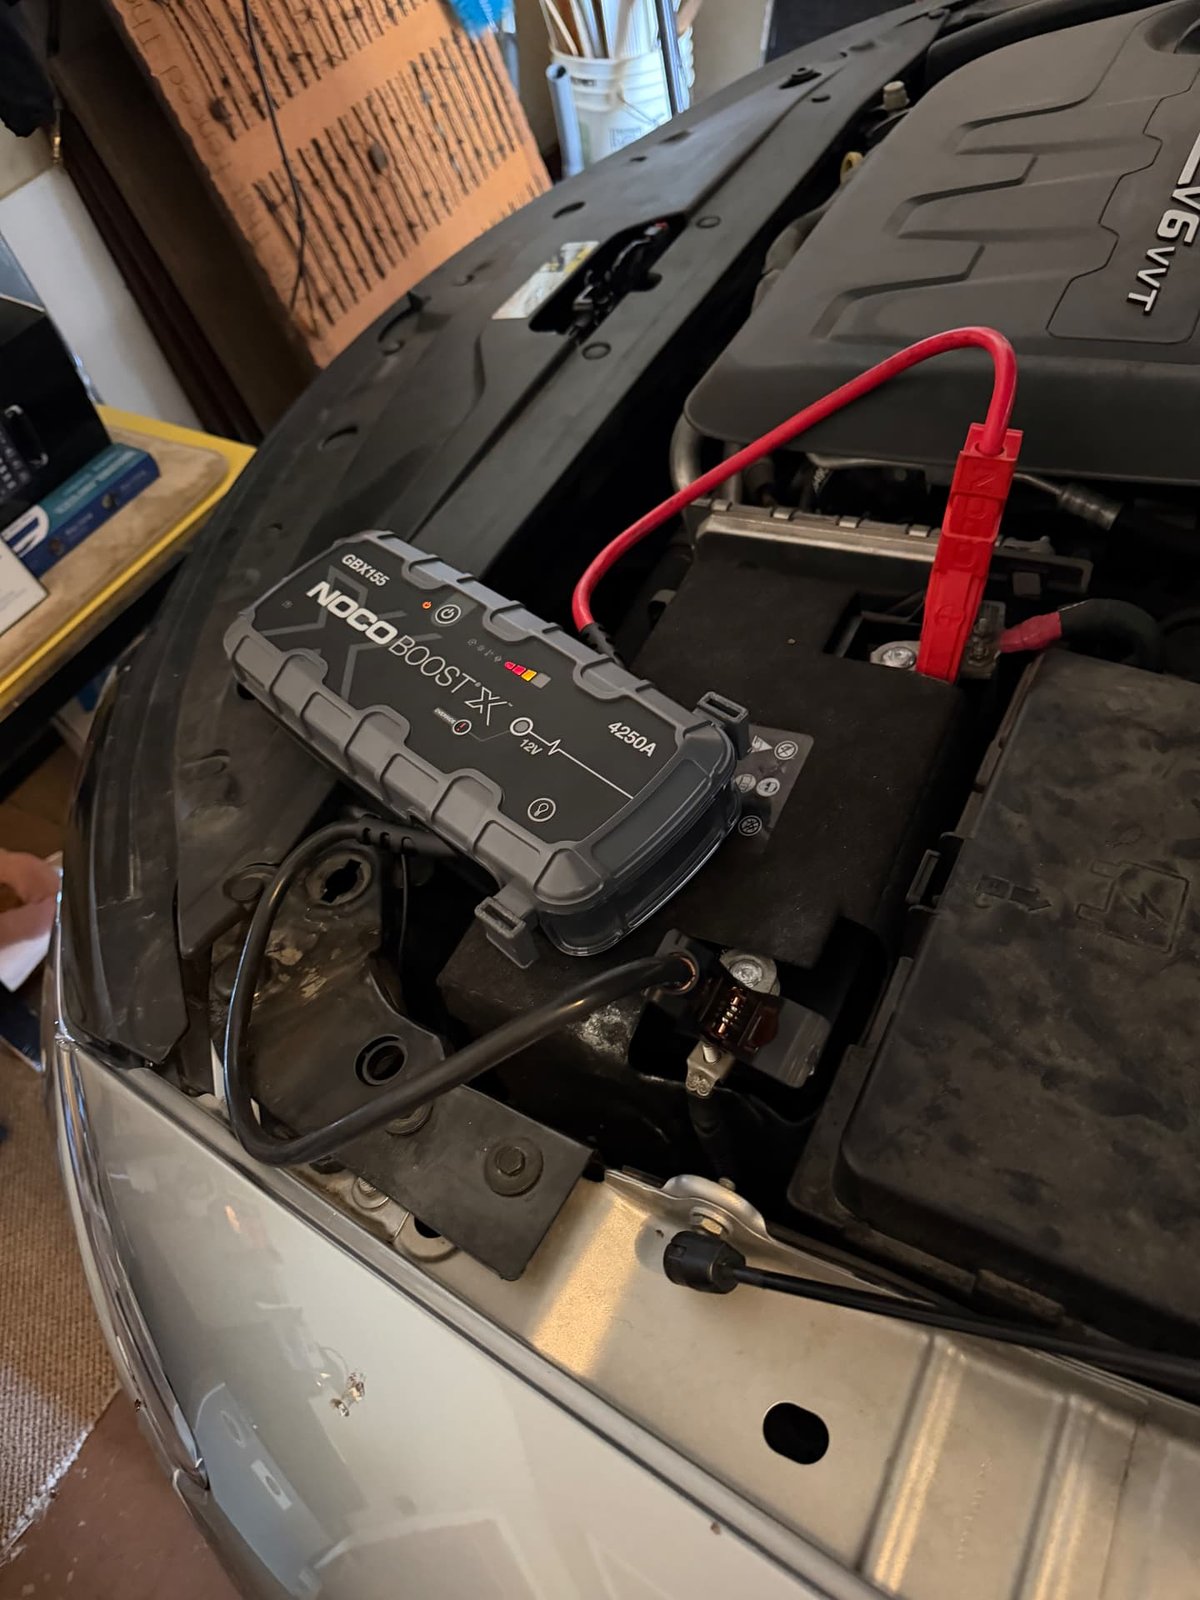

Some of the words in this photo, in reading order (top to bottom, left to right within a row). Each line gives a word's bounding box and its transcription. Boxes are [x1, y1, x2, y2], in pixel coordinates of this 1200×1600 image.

[1156, 186, 1200, 244] V6
[1127, 246, 1176, 313] VVT
[341, 554, 390, 587] GBX155
[306, 581, 398, 645] NOCO
[388, 635, 477, 694] BOOST
[519, 738, 543, 756] 12V
[607, 721, 657, 757] 4250A
